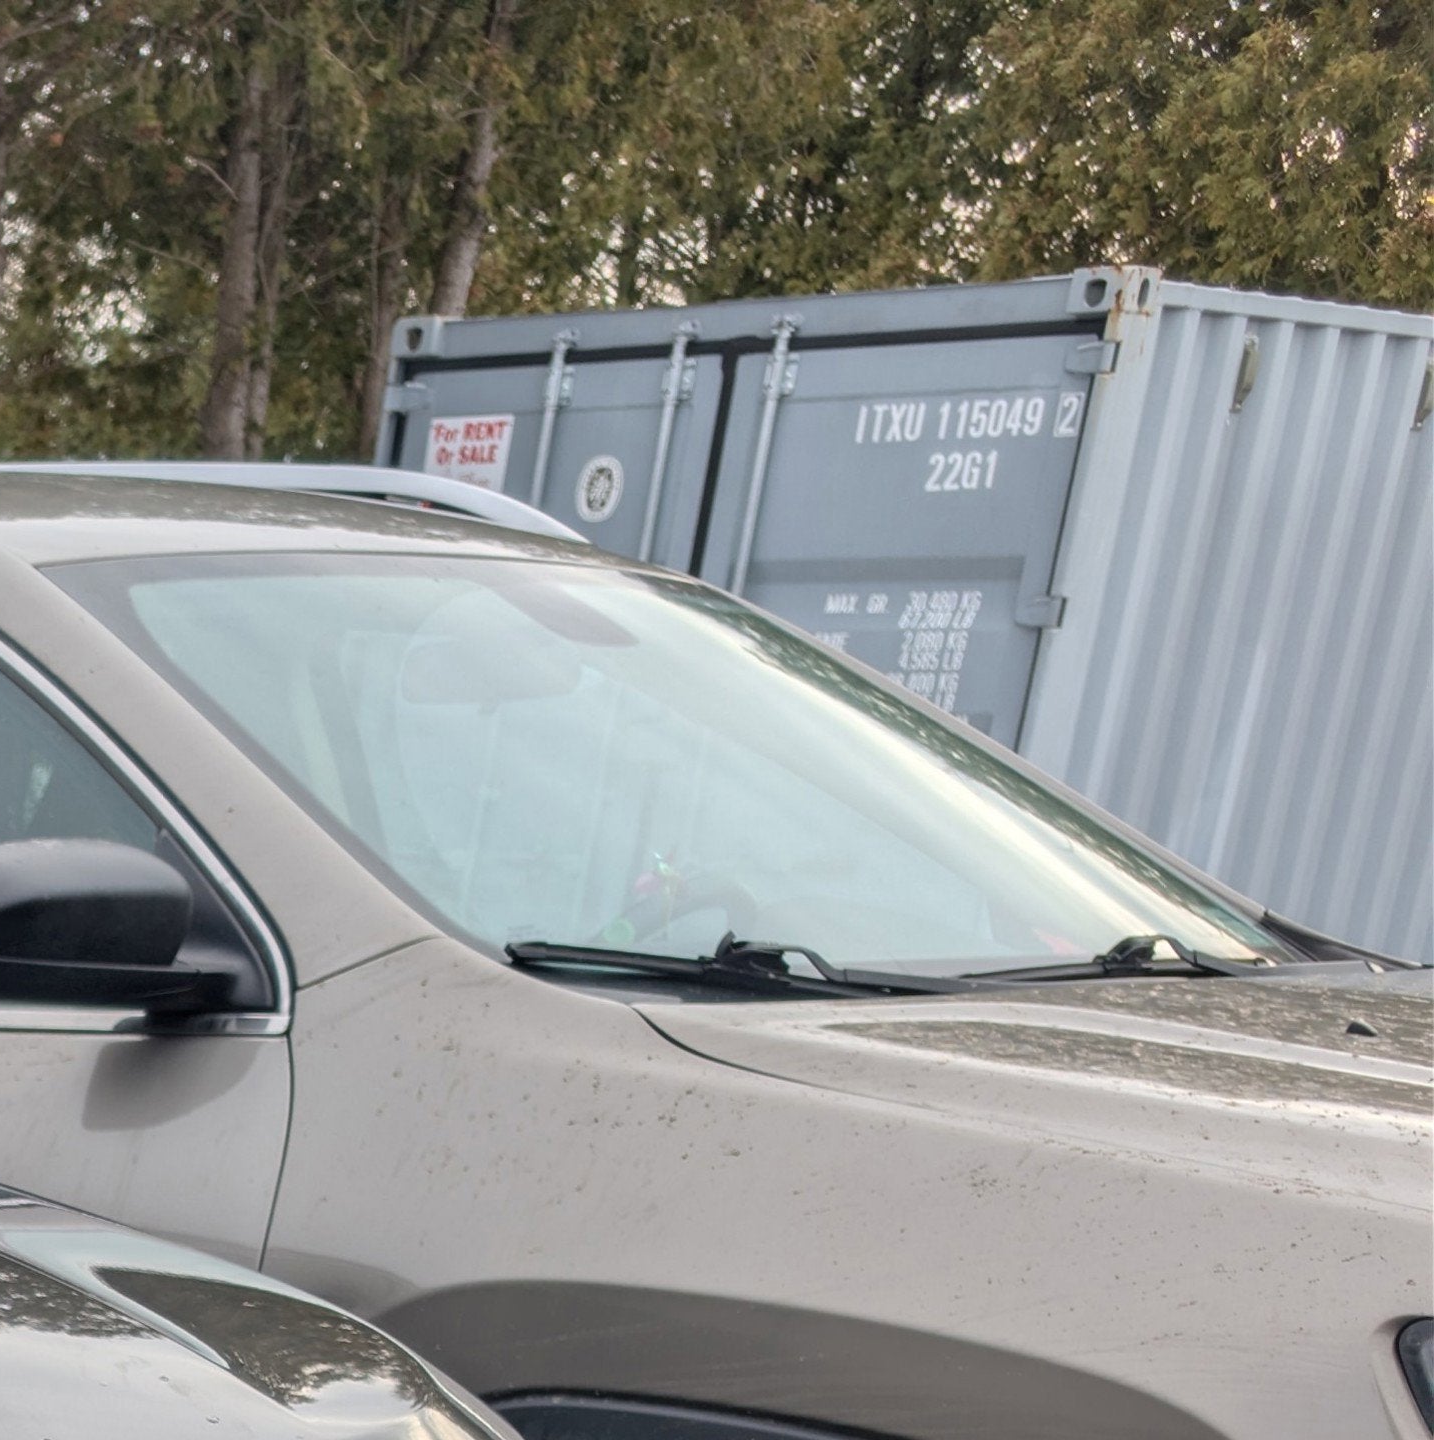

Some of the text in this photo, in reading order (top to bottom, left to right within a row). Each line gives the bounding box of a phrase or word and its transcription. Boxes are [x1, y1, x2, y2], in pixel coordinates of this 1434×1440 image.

[855, 394, 1081, 443] ITXU 115049 2
[433, 420, 508, 442] For RENT
[458, 445, 498, 465] SALE
[925, 450, 999, 492] 22G1
[946, 630, 969, 651] KG
